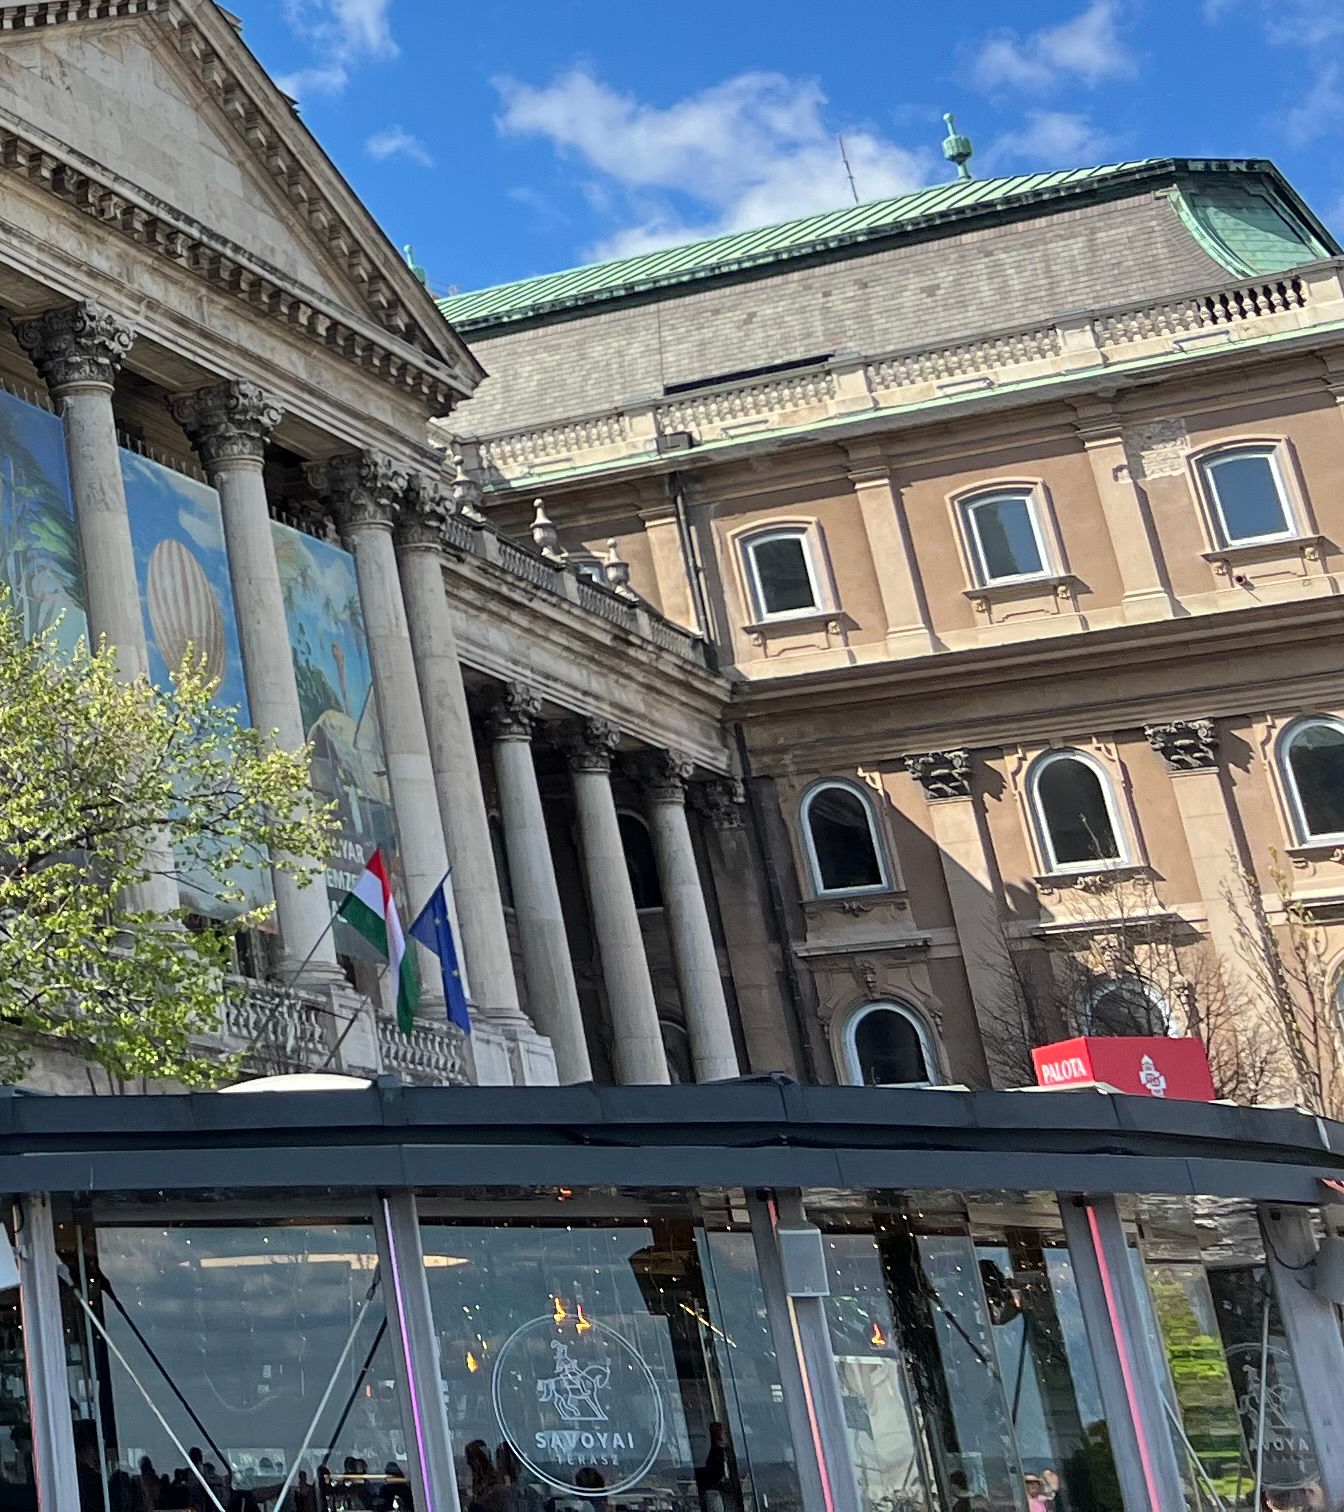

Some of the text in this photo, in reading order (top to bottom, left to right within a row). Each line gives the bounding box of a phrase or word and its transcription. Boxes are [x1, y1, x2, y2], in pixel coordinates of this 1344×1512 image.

[1041, 1057, 1087, 1084] PALOTA
[535, 1431, 634, 1449] SAVOYAI
[556, 1453, 620, 1466] TERASZ
